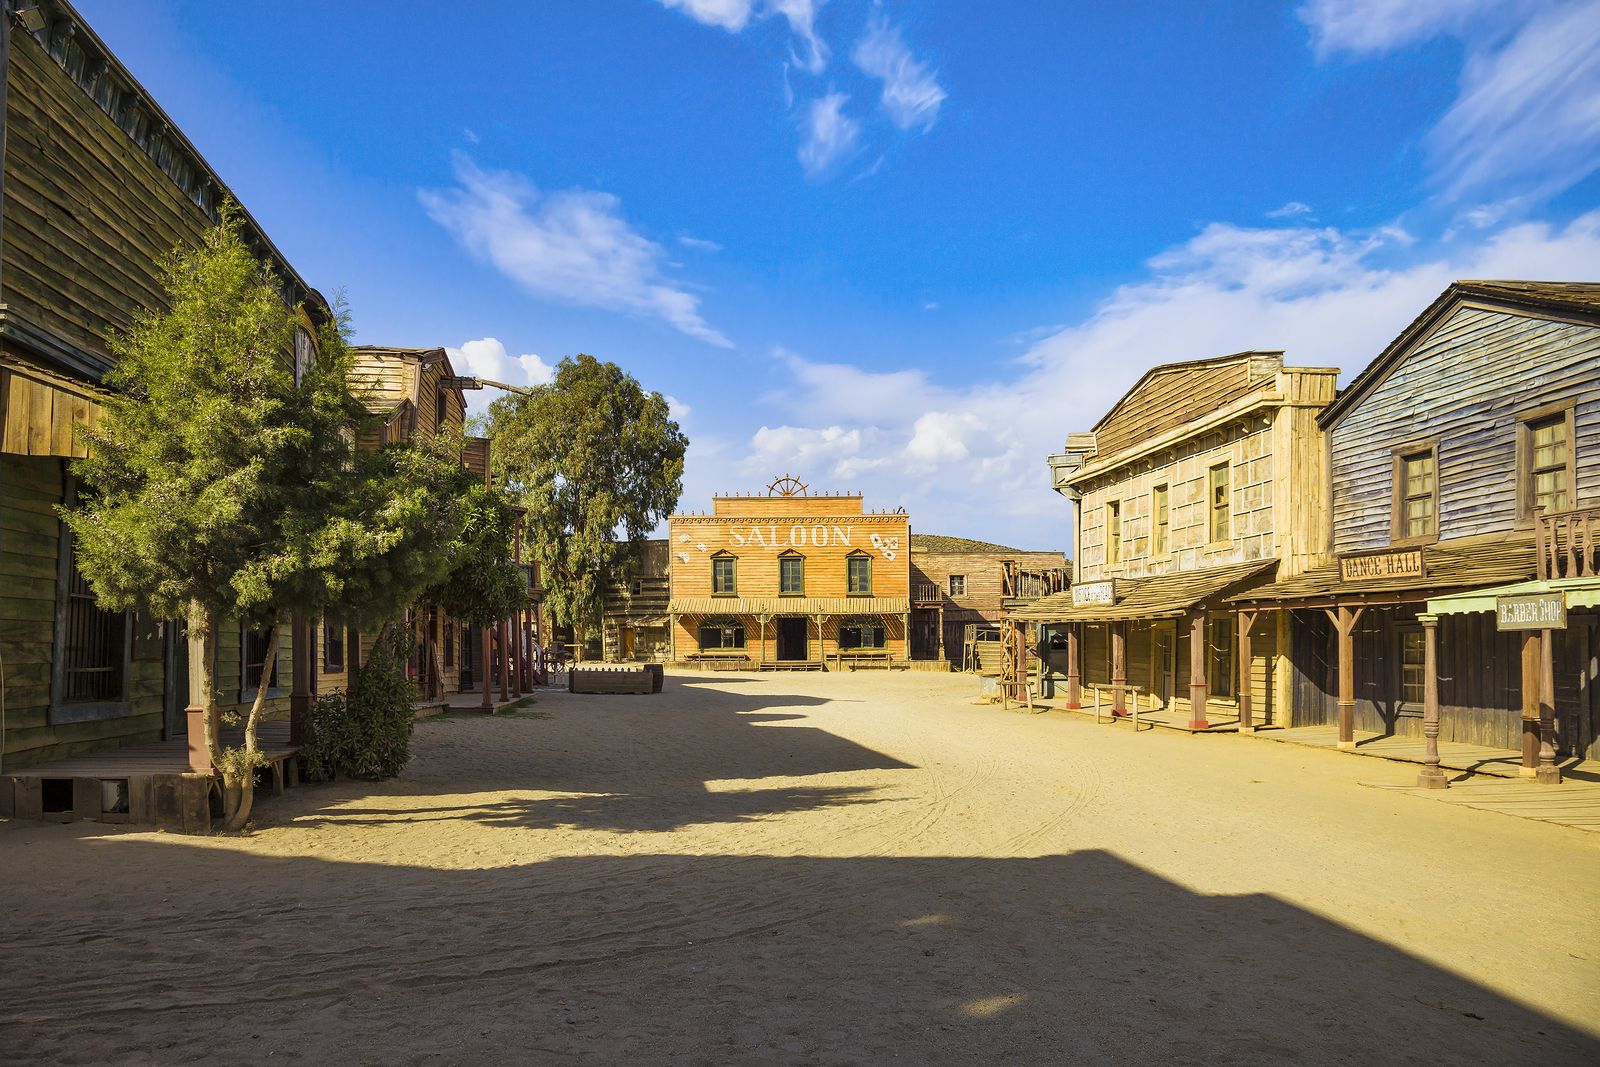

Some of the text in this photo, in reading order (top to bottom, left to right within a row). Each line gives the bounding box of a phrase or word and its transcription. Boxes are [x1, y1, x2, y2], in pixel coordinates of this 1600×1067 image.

[729, 525, 854, 547] SALOON
[1345, 552, 1420, 577] DANCE HALL
[1539, 598, 1562, 622] SHOP
